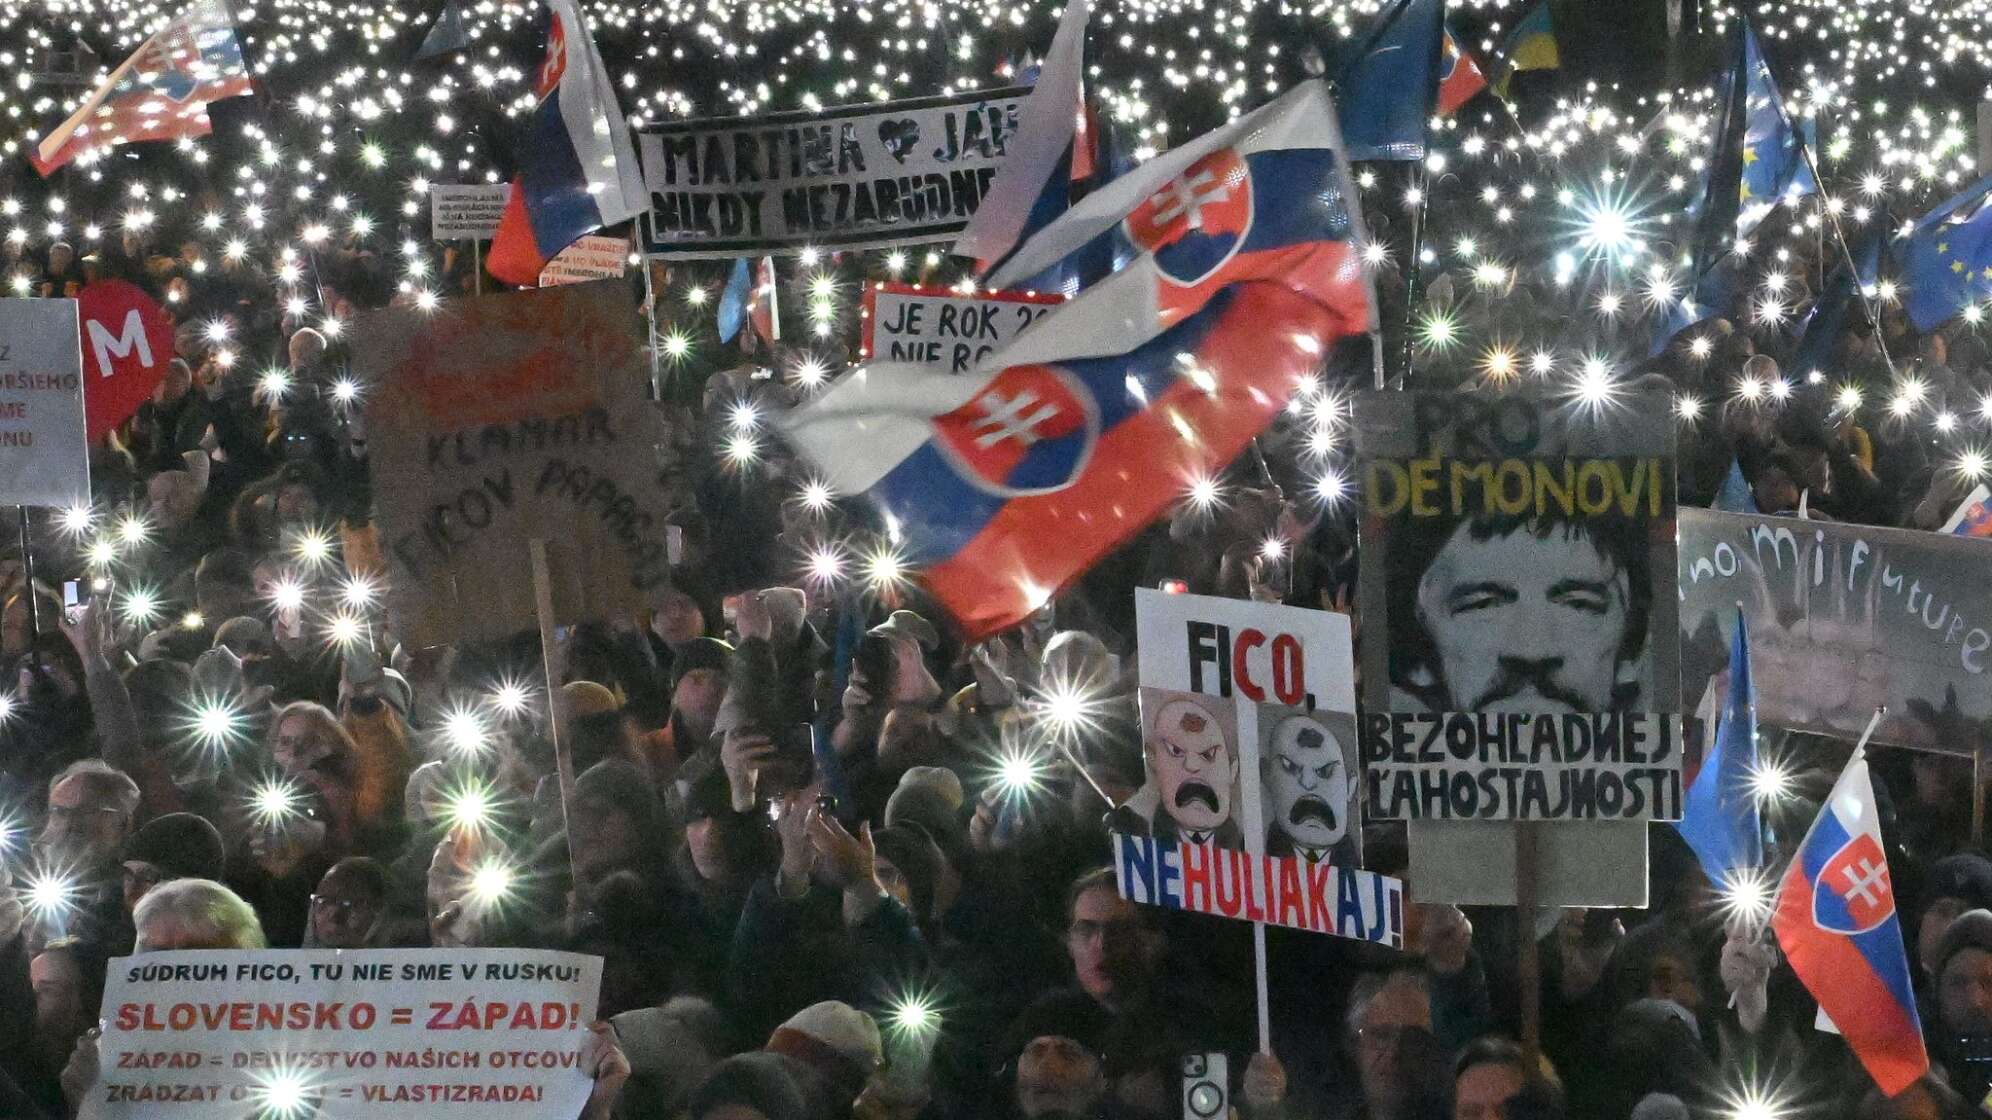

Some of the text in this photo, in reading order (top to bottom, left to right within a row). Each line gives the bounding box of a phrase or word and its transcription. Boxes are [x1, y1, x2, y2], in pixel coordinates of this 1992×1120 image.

[663, 122, 866, 185] MARTINA
[651, 191, 765, 239] NIKDY
[884, 303, 1048, 340] JE ROK 2
[86, 309, 154, 377] M
[0, 370, 79, 389] RŠIEHO
[0, 431, 32, 446] NU
[1413, 398, 1541, 458] PRO
[1187, 620, 1317, 711] FICO,
[1121, 832, 1402, 947] NEHULIAKAJ!
[235, 963, 300, 985] FICO,
[310, 964, 343, 981] TU
[352, 964, 393, 981] NIE
[401, 964, 452, 982] SME
[462, 964, 478, 981] V
[485, 964, 580, 983] RUSKU!
[115, 1002, 377, 1032] SLOVENSKO
[426, 996, 580, 1031] ZÁPAD!
[385, 1048, 480, 1069] NAŠICH
[362, 1084, 544, 1103] VLASTIZRADA!
